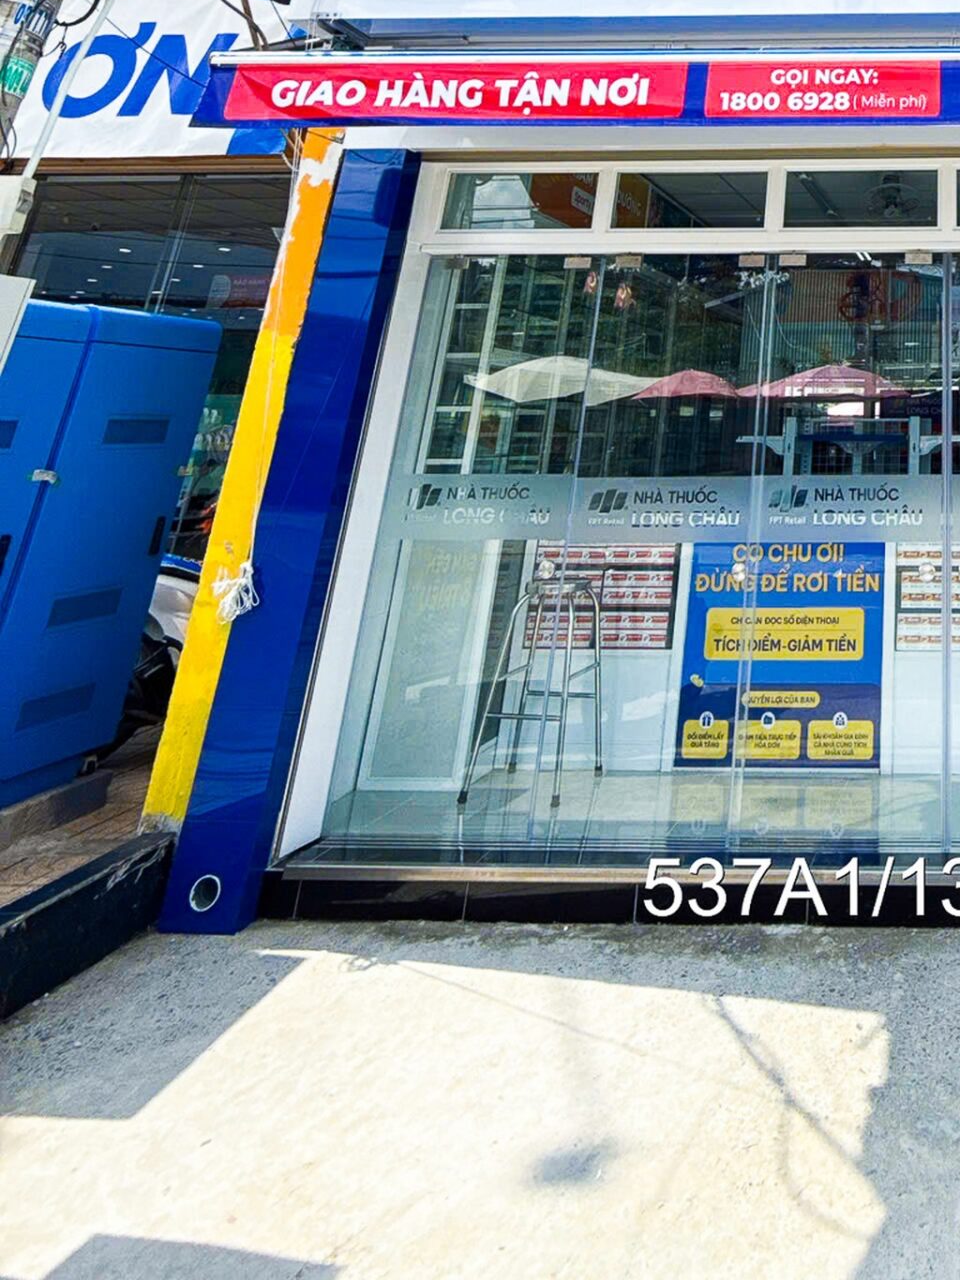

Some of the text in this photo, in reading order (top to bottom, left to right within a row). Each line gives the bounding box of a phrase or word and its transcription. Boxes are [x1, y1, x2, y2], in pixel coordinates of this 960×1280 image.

[770, 68, 879, 89] GỌI NGAY:
[271, 71, 650, 116] GIAO HÀNG TẬN NƠI
[720, 91, 927, 111] 1800 6928 phí)
[447, 482, 530, 500] NHÀ THUỐC
[634, 485, 718, 504] NHÀ THUỐC
[814, 482, 899, 501] NHÀ THUỐC
[444, 507, 496, 524] LONG
[632, 506, 740, 528] LONG CHÂU
[813, 504, 923, 526] LONG CHÂU
[695, 568, 756, 593] ĐỪNG
[761, 564, 790, 592] ĐỂ
[793, 570, 828, 592] RƠI
[836, 565, 880, 592] TIỀN
[783, 615, 795, 625] SỐ
[713, 633, 857, 652] TÍCH TIỀN
